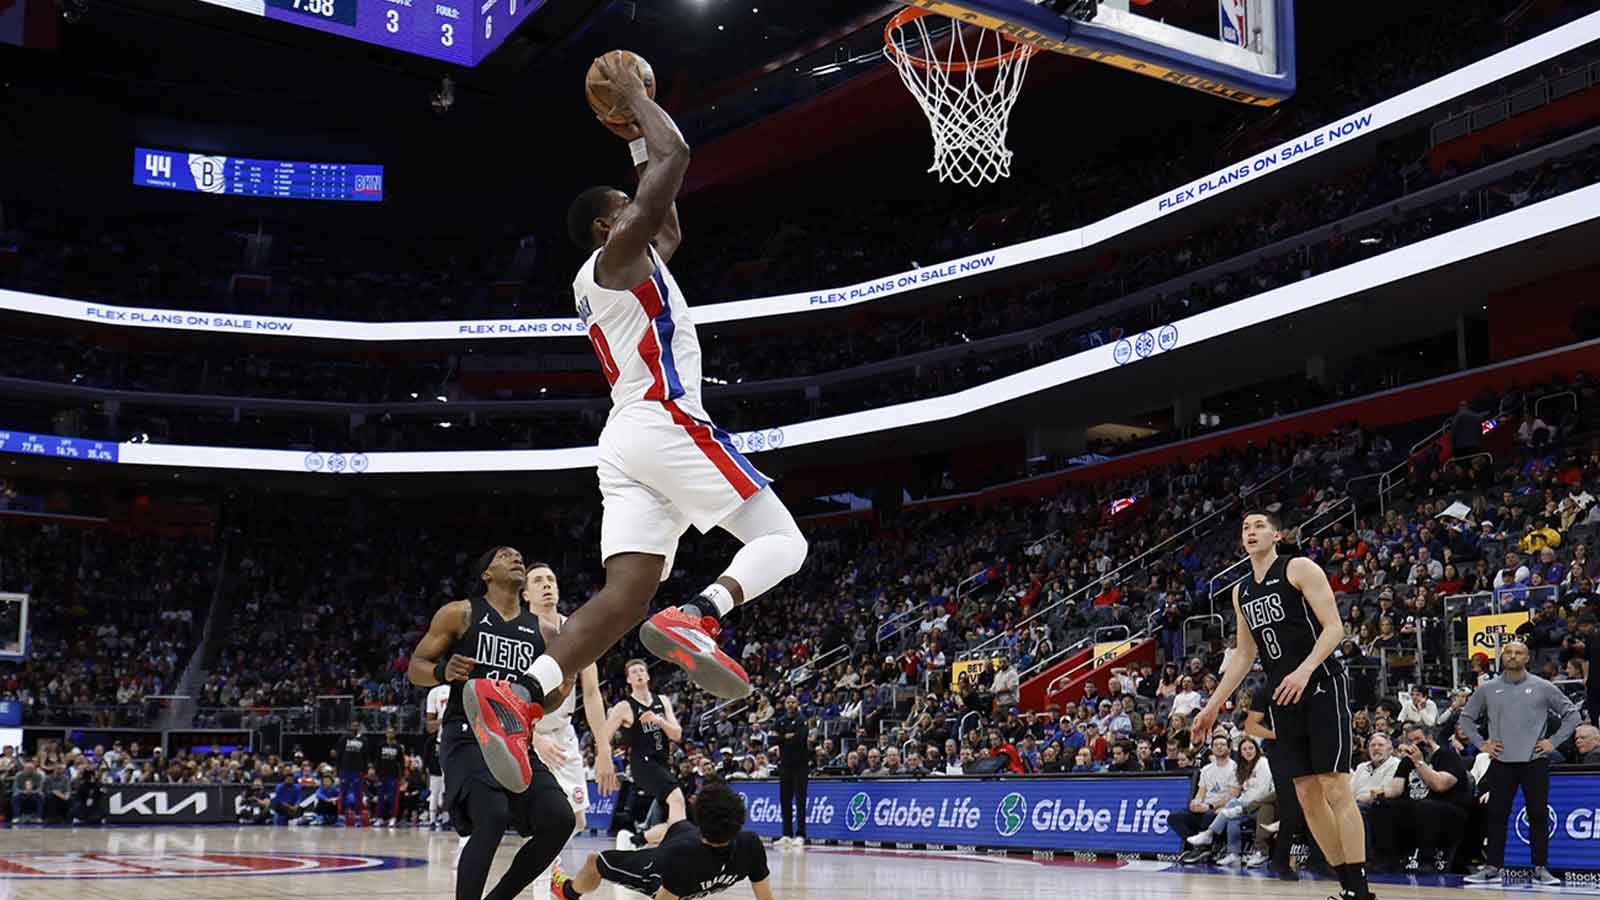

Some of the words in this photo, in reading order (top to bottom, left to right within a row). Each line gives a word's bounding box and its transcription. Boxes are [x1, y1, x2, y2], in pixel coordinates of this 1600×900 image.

[386, 9, 400, 33] 3
[440, 23, 454, 47] 3
[484, 15, 493, 39] 6
[145, 154, 171, 178] 44
[1158, 188, 1195, 211] FLEX
[1199, 166, 1250, 194] PLANS
[1253, 154, 1277, 171] ON
[1281, 134, 1325, 160] SALE
[1329, 113, 1372, 141] NOW
[810, 293, 847, 305] FLEX
[850, 281, 895, 299] PLANS
[897, 275, 918, 287] ON
[921, 265, 957, 282] SALE
[960, 255, 996, 272] NOW
[86, 307, 126, 320] FLEX
[130, 312, 183, 325] PLANS
[187, 316, 209, 326] ON
[213, 318, 252, 329] SALE
[256, 321, 293, 331] NOW
[459, 324, 495, 334] FLEX
[500, 323, 547, 333] PLANS
[551, 322, 573, 332] ON
[1241, 593, 1285, 630] NETS
[476, 632, 534, 673] NETS
[1262, 627, 1282, 659] 8
[874, 798, 935, 828] Globe
[937, 797, 980, 829] Life
[1032, 799, 1111, 832] Globe
[1116, 797, 1170, 834] Life
